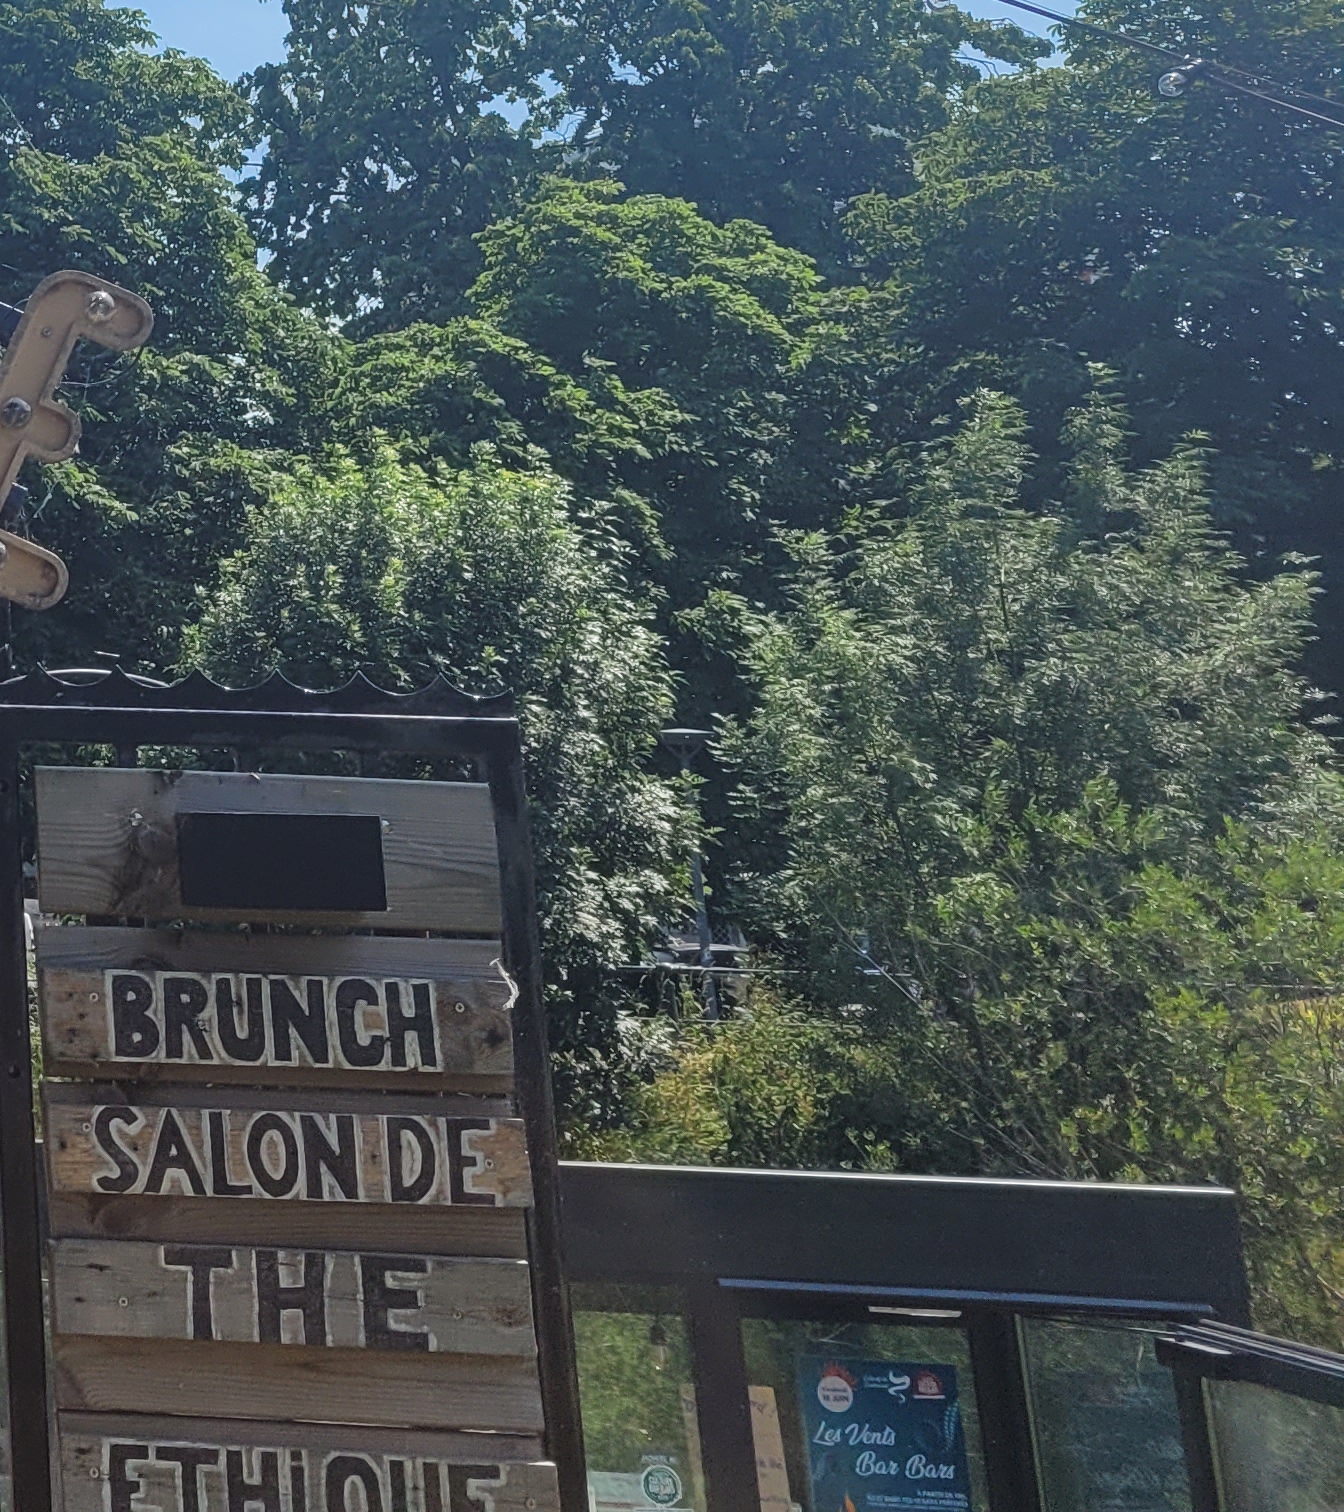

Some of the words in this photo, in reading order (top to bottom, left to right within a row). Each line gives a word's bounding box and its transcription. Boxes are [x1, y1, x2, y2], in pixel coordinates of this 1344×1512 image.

[111, 973, 439, 1070] BRUNCH
[93, 1105, 359, 1202] SALON
[384, 1116, 497, 1206] DE
[163, 1246, 430, 1352] THE
[812, 1421, 841, 1446] Les
[844, 1423, 897, 1447] Vents
[855, 1450, 900, 1477] Bar
[904, 1453, 956, 1480] Bars
